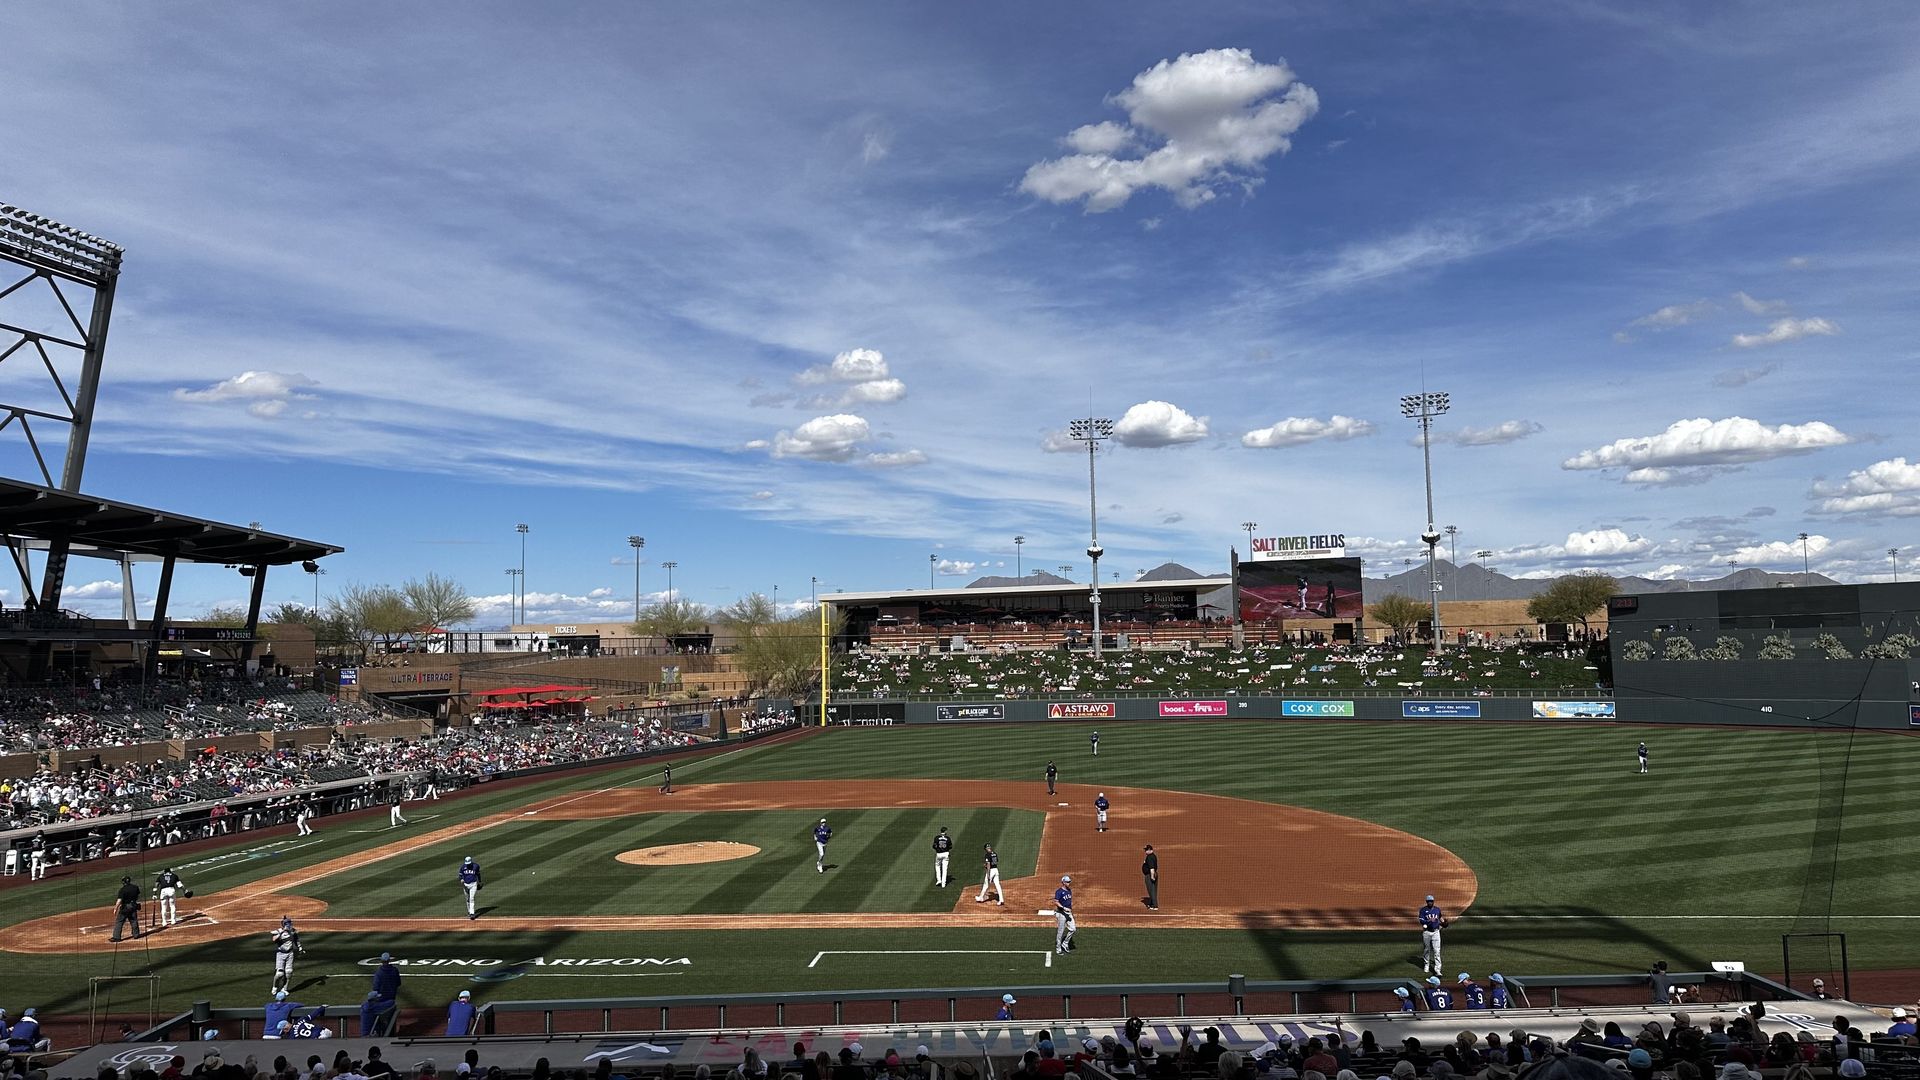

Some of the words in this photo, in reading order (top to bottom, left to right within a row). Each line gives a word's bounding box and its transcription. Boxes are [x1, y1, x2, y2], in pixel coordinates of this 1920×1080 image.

[1253, 538, 1276, 552] SALT
[1278, 536, 1308, 551] RIVER
[1310, 534, 1345, 549] FIELDS
[555, 626, 577, 634] TICKETS
[390, 674, 417, 683] ULTRA
[423, 673, 453, 682] TERRACE
[1064, 705, 1109, 713] ASTRAVO
[1290, 705, 1314, 713] COX
[1321, 704, 1345, 713] COX
[1437, 996, 1446, 1009] 8
[1477, 992, 1484, 1005] 9
[299, 1021, 315, 1038] 64
